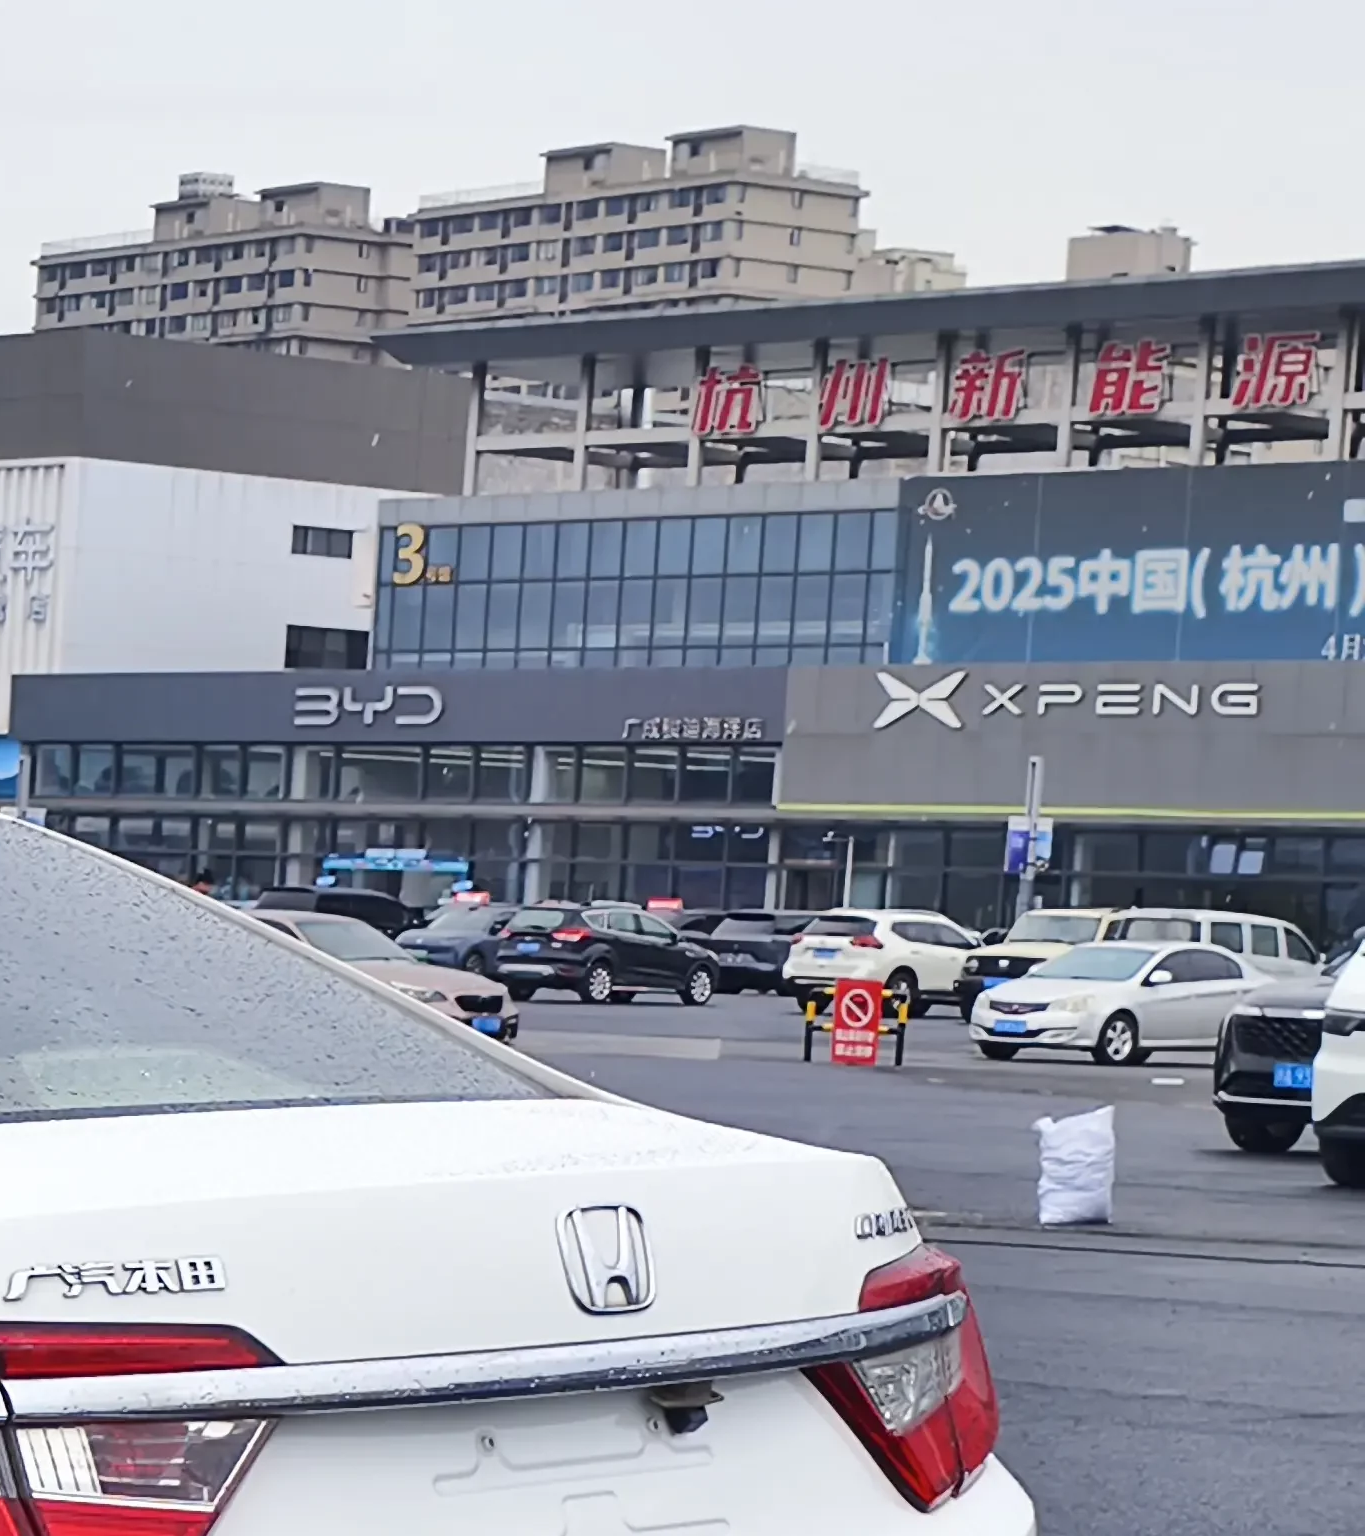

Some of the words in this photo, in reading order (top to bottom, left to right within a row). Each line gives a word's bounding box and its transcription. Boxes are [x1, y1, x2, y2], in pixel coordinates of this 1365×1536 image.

[692, 332, 1320, 435] 杭州新能源
[1321, 634, 1365, 662] 4月
[294, 685, 443, 726] BYD
[982, 682, 1260, 717] XPENG
[2, 1255, 227, 1304] 广汽本田
